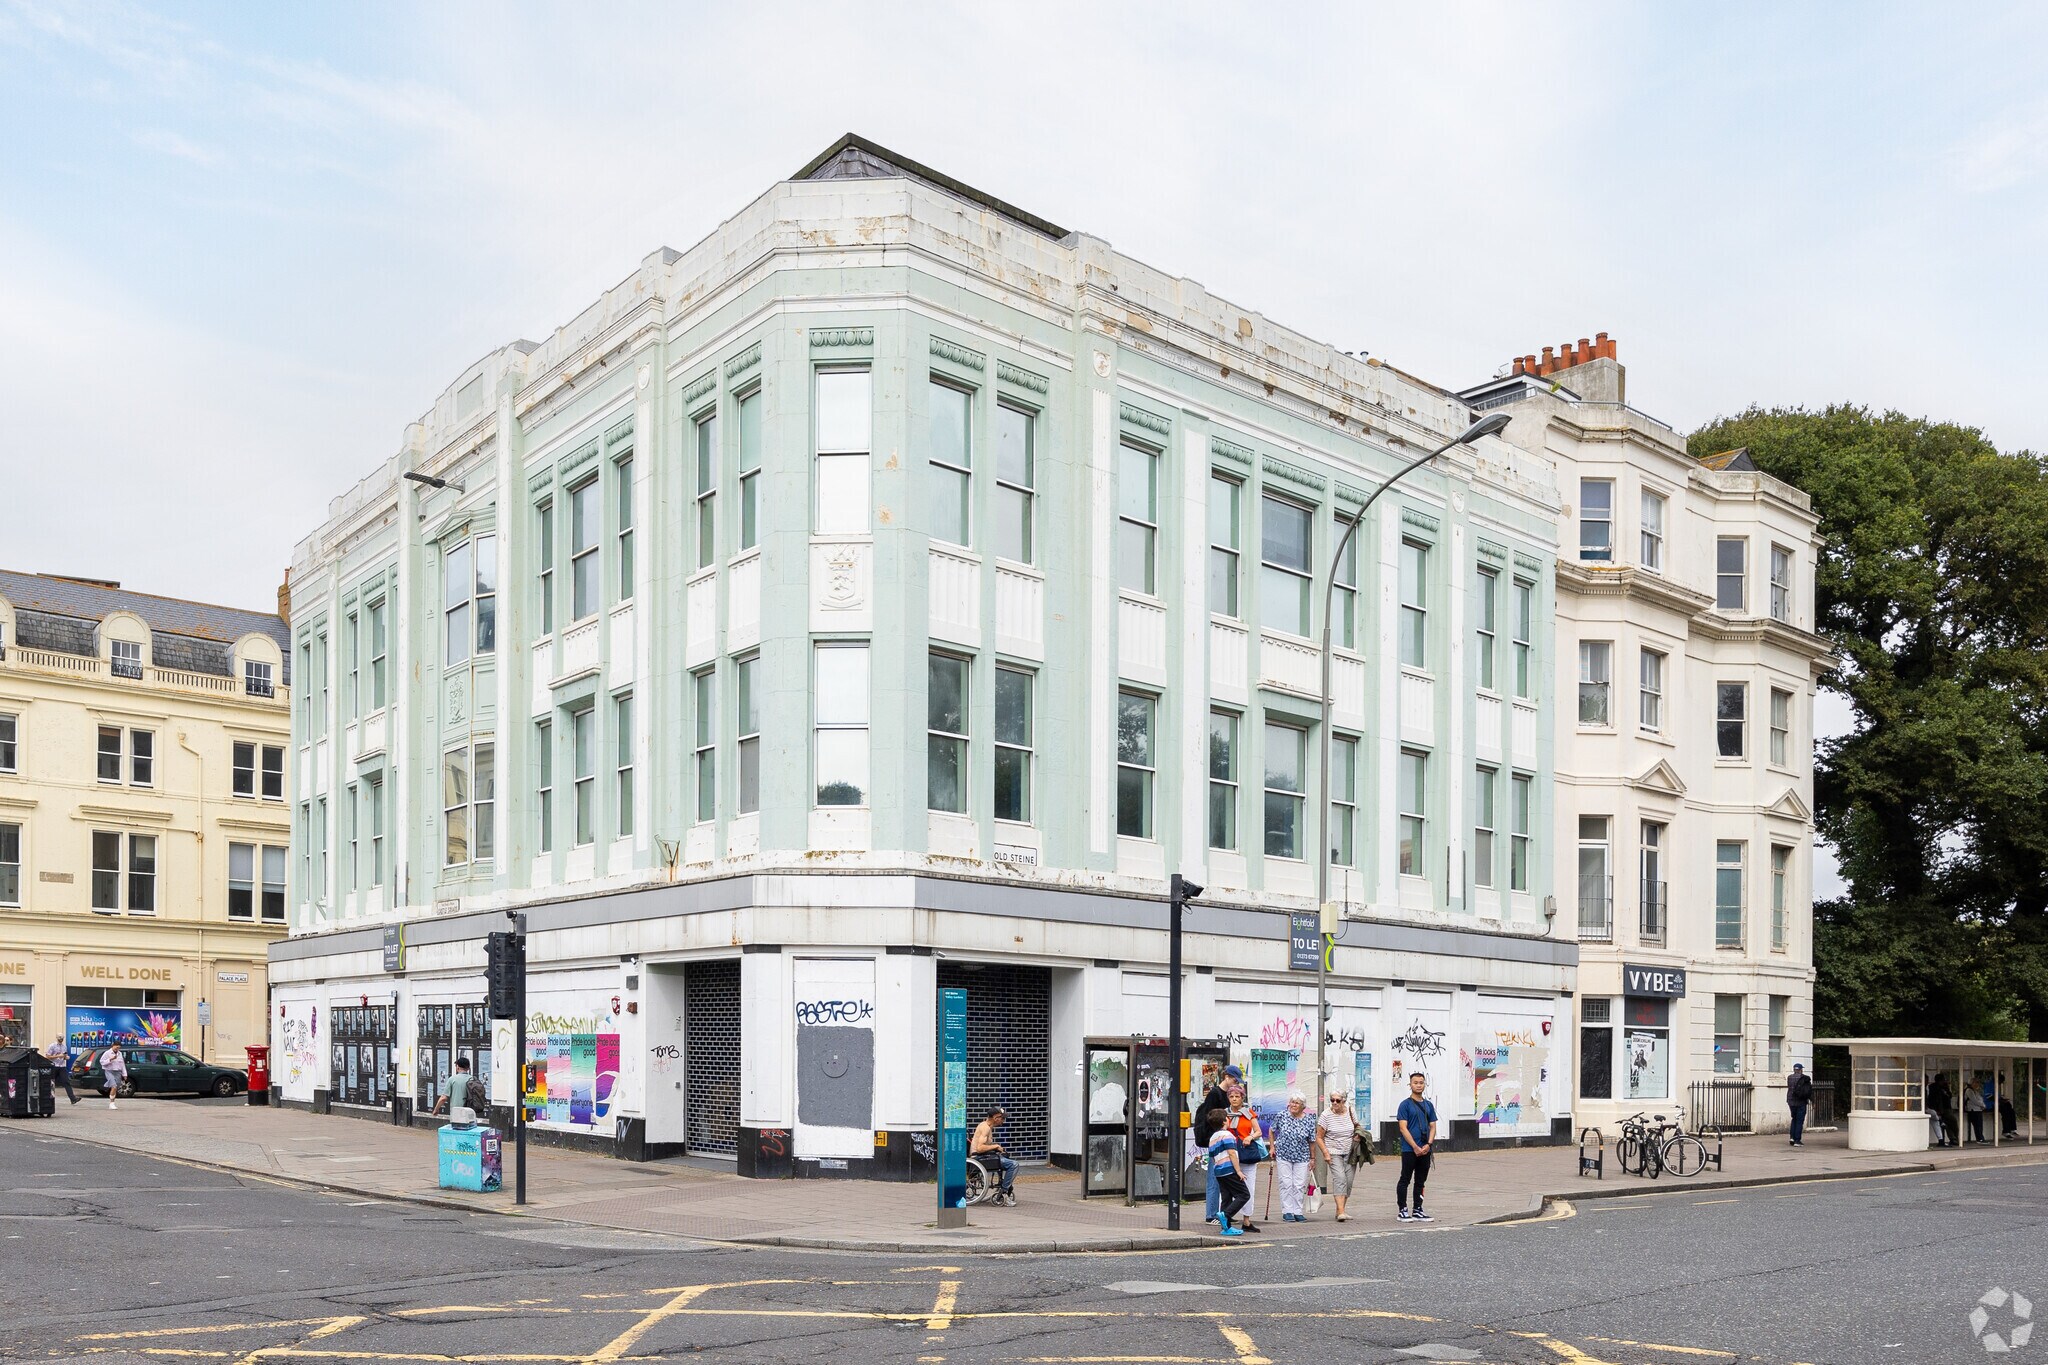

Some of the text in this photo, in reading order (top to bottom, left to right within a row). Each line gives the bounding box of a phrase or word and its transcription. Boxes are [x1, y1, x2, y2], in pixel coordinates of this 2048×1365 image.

[993, 851, 1034, 864] OLD STEINE
[1292, 917, 1315, 931] Eightfold
[384, 943, 399, 955] TO LET
[1292, 937, 1320, 951] TO LET
[81, 965, 171, 981] WELL DONE
[1629, 970, 1674, 992] VYBE
[536, 1037, 547, 1046] looks
[547, 1037, 571, 1046] Pride looks
[571, 1037, 596, 1046] Pride looks
[535, 1047, 547, 1058] good
[558, 1048, 571, 1059] good
[582, 1048, 596, 1059] good
[1269, 1052, 1285, 1061] looks
[1483, 1048, 1496, 1056] looks
[1496, 1048, 1509, 1057] Pride
[1482, 1057, 1496, 1066] good
[1268, 1063, 1286, 1073] good
